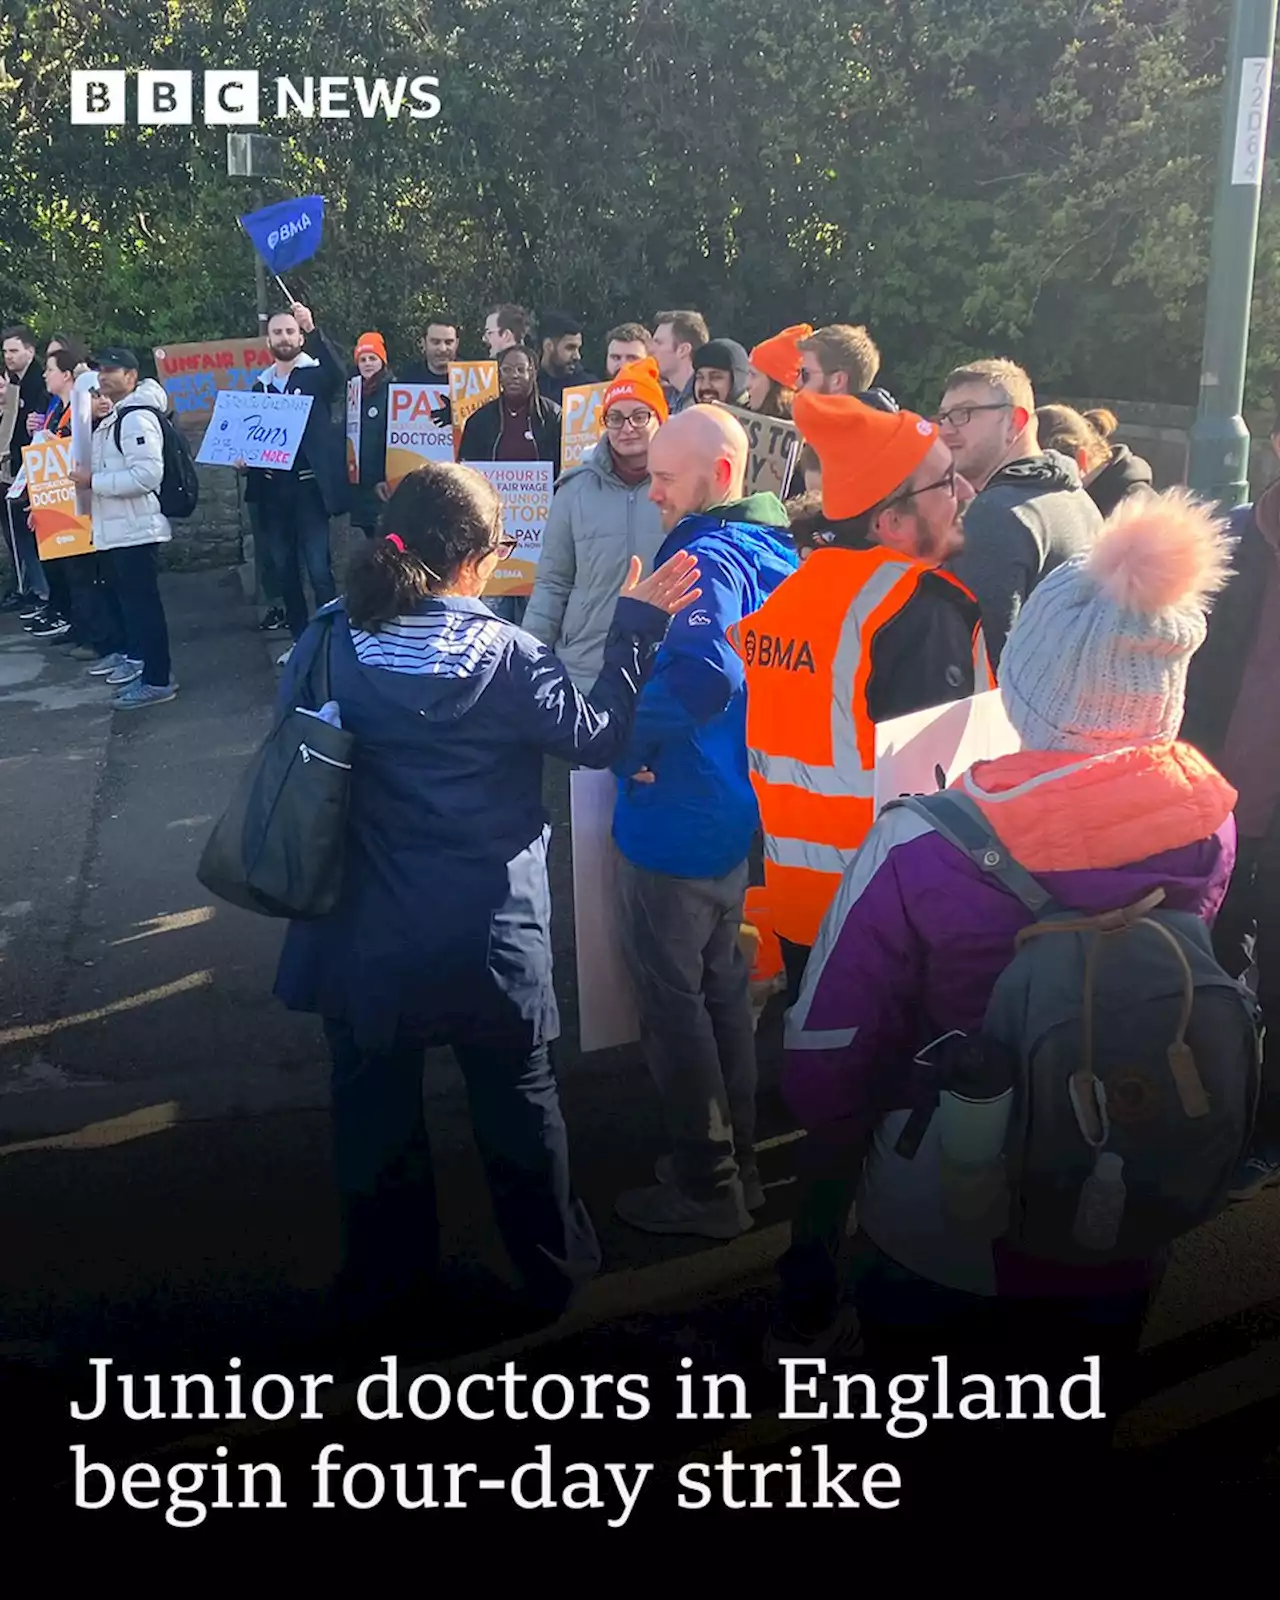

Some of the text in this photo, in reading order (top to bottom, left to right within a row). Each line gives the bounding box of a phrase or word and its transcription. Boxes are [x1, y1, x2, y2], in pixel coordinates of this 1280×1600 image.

[280, 212, 312, 241] BMA
[163, 350, 234, 375] UNFAIR
[243, 413, 288, 447] Fans
[390, 432, 453, 445] DOCTORS
[769, 426, 796, 459] TO
[260, 449, 291, 464] MORE
[536, 469, 549, 481] IS
[520, 482, 549, 492] WAGE
[515, 529, 542, 541] PAY
[758, 634, 816, 675] BMA
